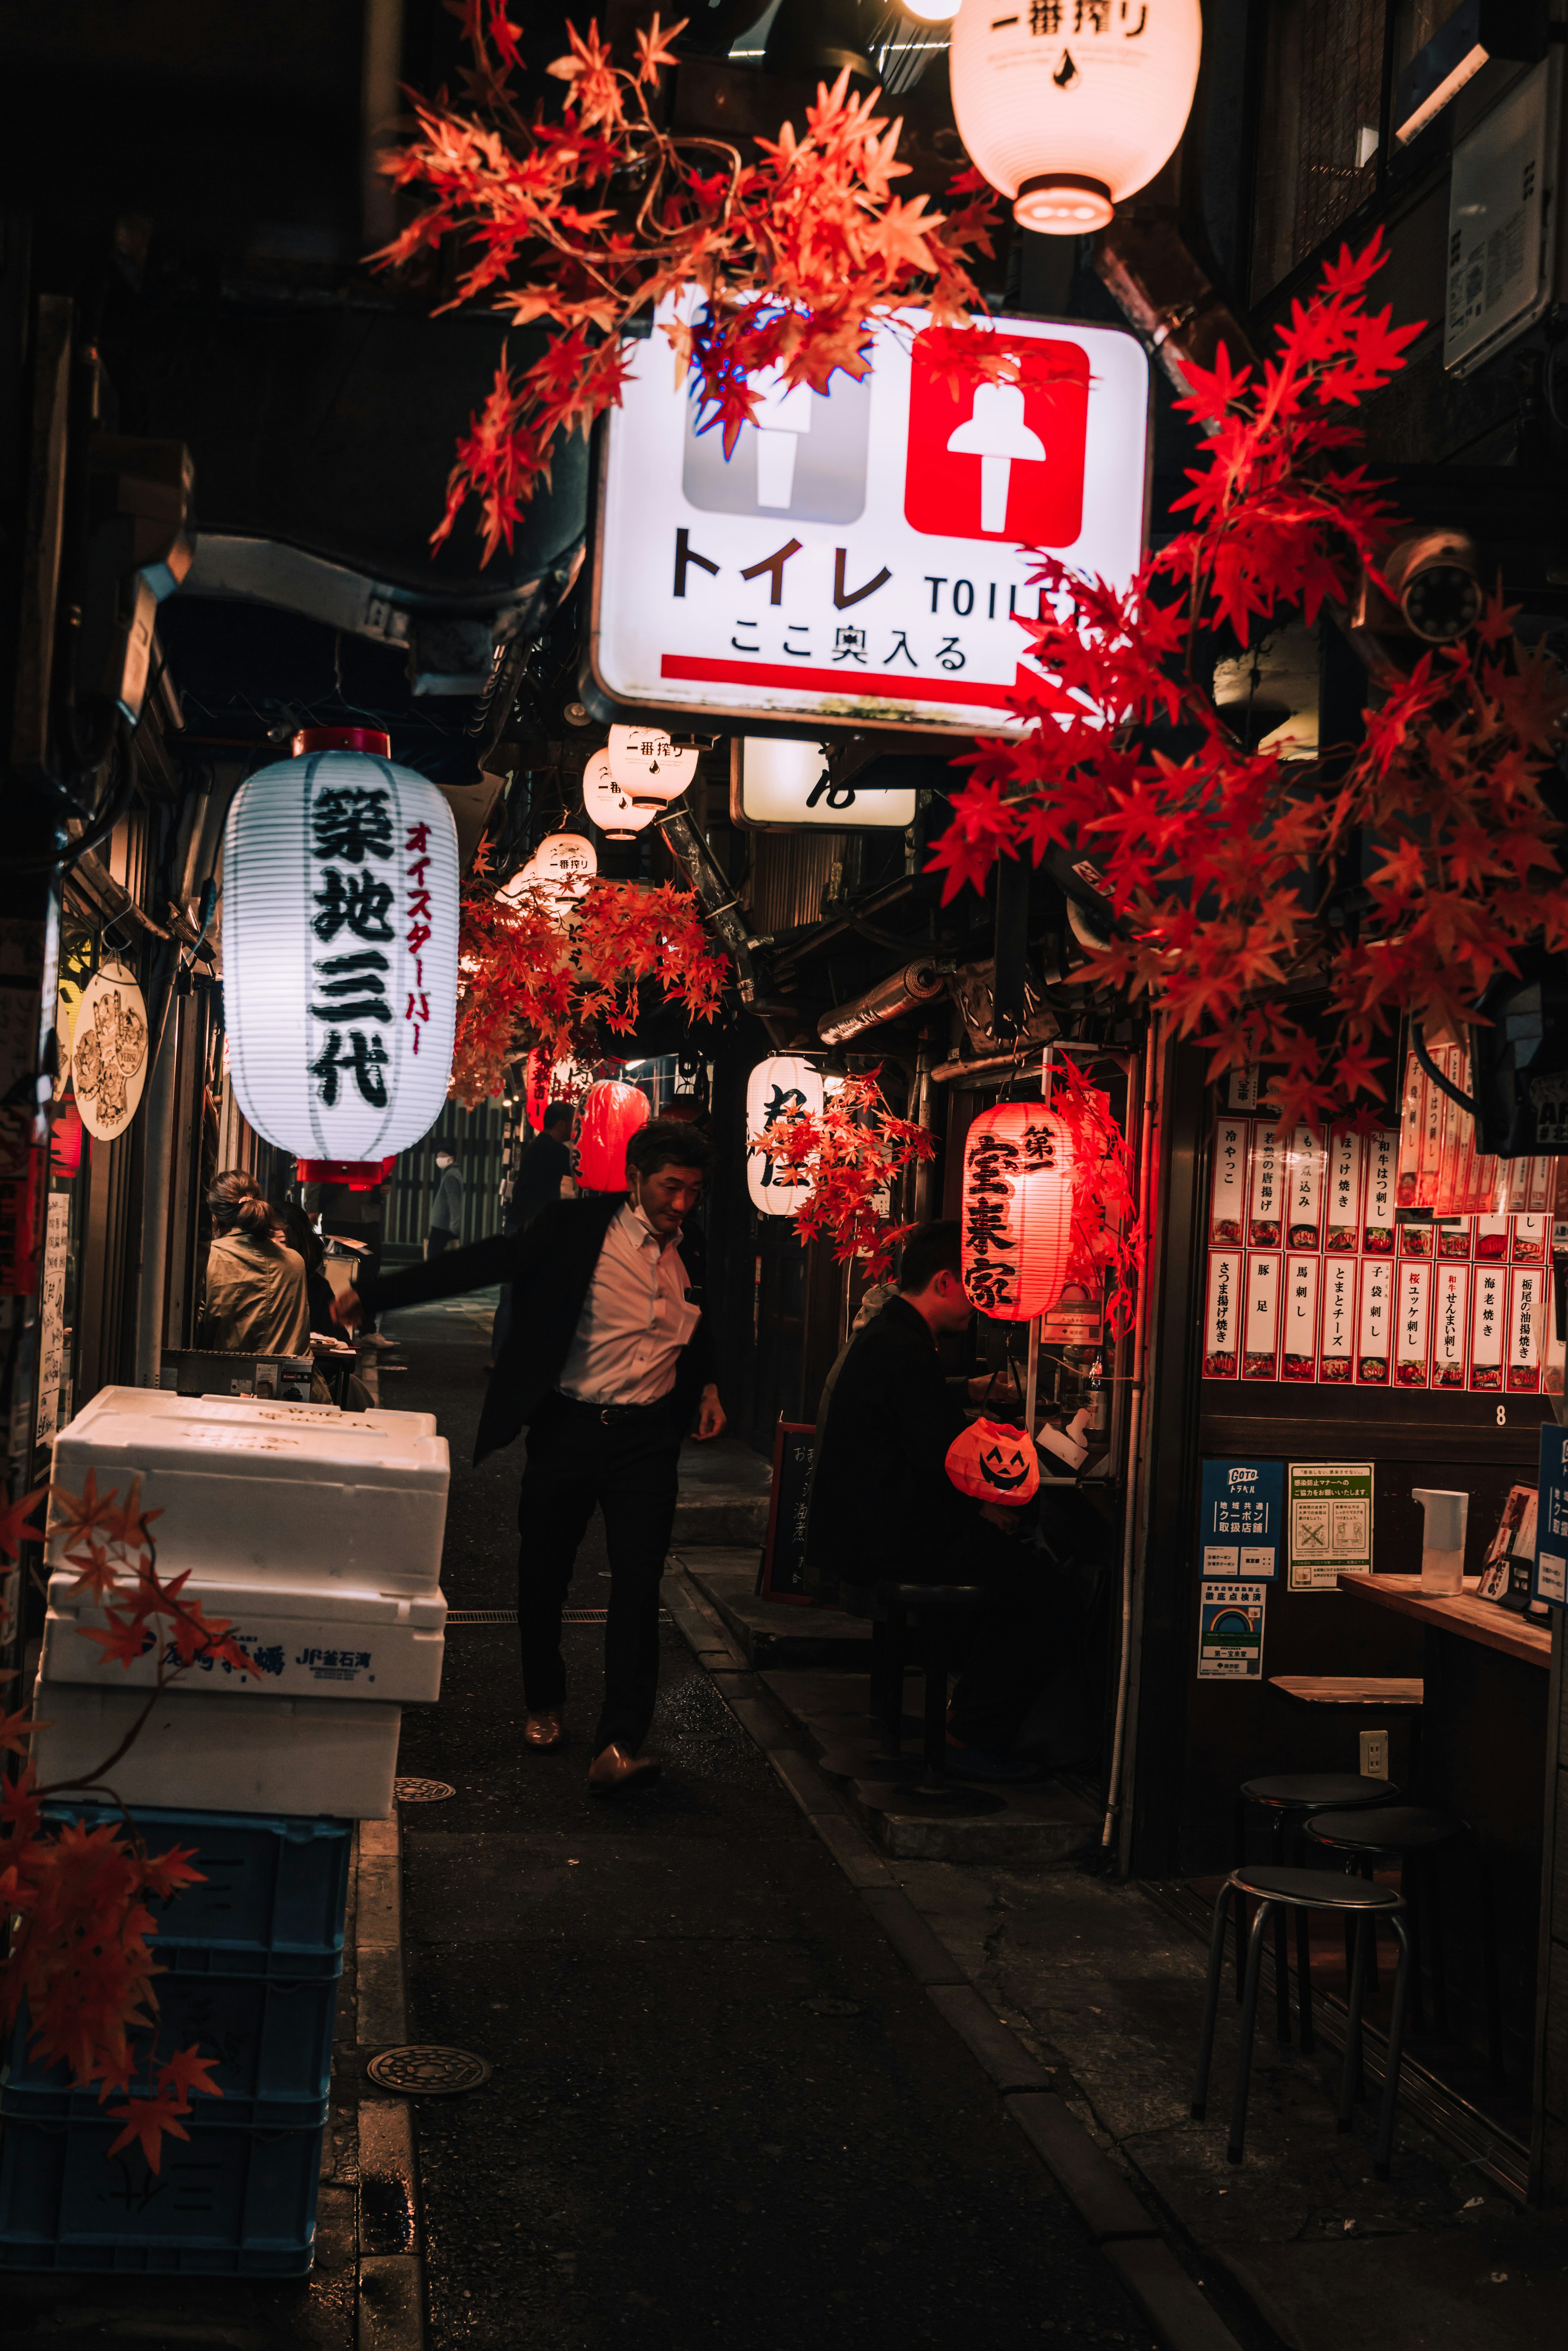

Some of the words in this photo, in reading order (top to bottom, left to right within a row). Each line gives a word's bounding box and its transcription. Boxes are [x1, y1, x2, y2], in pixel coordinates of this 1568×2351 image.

[990, 0, 1148, 38] 一番搾り
[673, 527, 893, 611] トイレ
[731, 620, 966, 671] ここ奥入る
[626, 742, 683, 758] 一番搾り
[550, 859, 588, 869] 一番搾り
[306, 785, 396, 1109] 築地三代
[405, 821, 432, 1055] オイスターバー
[1024, 1125, 1056, 1172] 第一
[1224, 1130, 1237, 1184] 冷やっこ
[1298, 1135, 1312, 1208] もつ煮込み
[1338, 1138, 1352, 1208] ほっけ焼き
[1376, 1140, 1390, 1217] 和牛はつ刺し
[1292, 1230, 1315, 1241] ¥380
[1330, 1233, 1354, 1243] ¥480
[1216, 1262, 1230, 1343] さつま揚げ焼き
[1256, 1264, 1270, 1312] 豚足
[1296, 1266, 1307, 1317] 馬刺し
[1332, 1267, 1344, 1346] とまとチーズ
[1370, 1266, 1383, 1337] 子袋刺し
[1407, 1273, 1421, 1345] 桜ユッケ刺し
[1483, 1277, 1495, 1336] 海老焼き
[1444, 1275, 1457, 1357] 和牛せんまい刺し
[1519, 1279, 1532, 1359] 栃尾の油揚焼き
[1362, 1365, 1385, 1375] ¥580
[1497, 1405, 1506, 1426] 8
[1220, 1501, 1263, 1510] 地域共通
[1230, 1485, 1255, 1493] トラベル
[1218, 1522, 1263, 1533] 取扱店舗
[1220, 1511, 1263, 1521] クーポン
[1205, 1592, 1261, 1602] 徹底点検済
